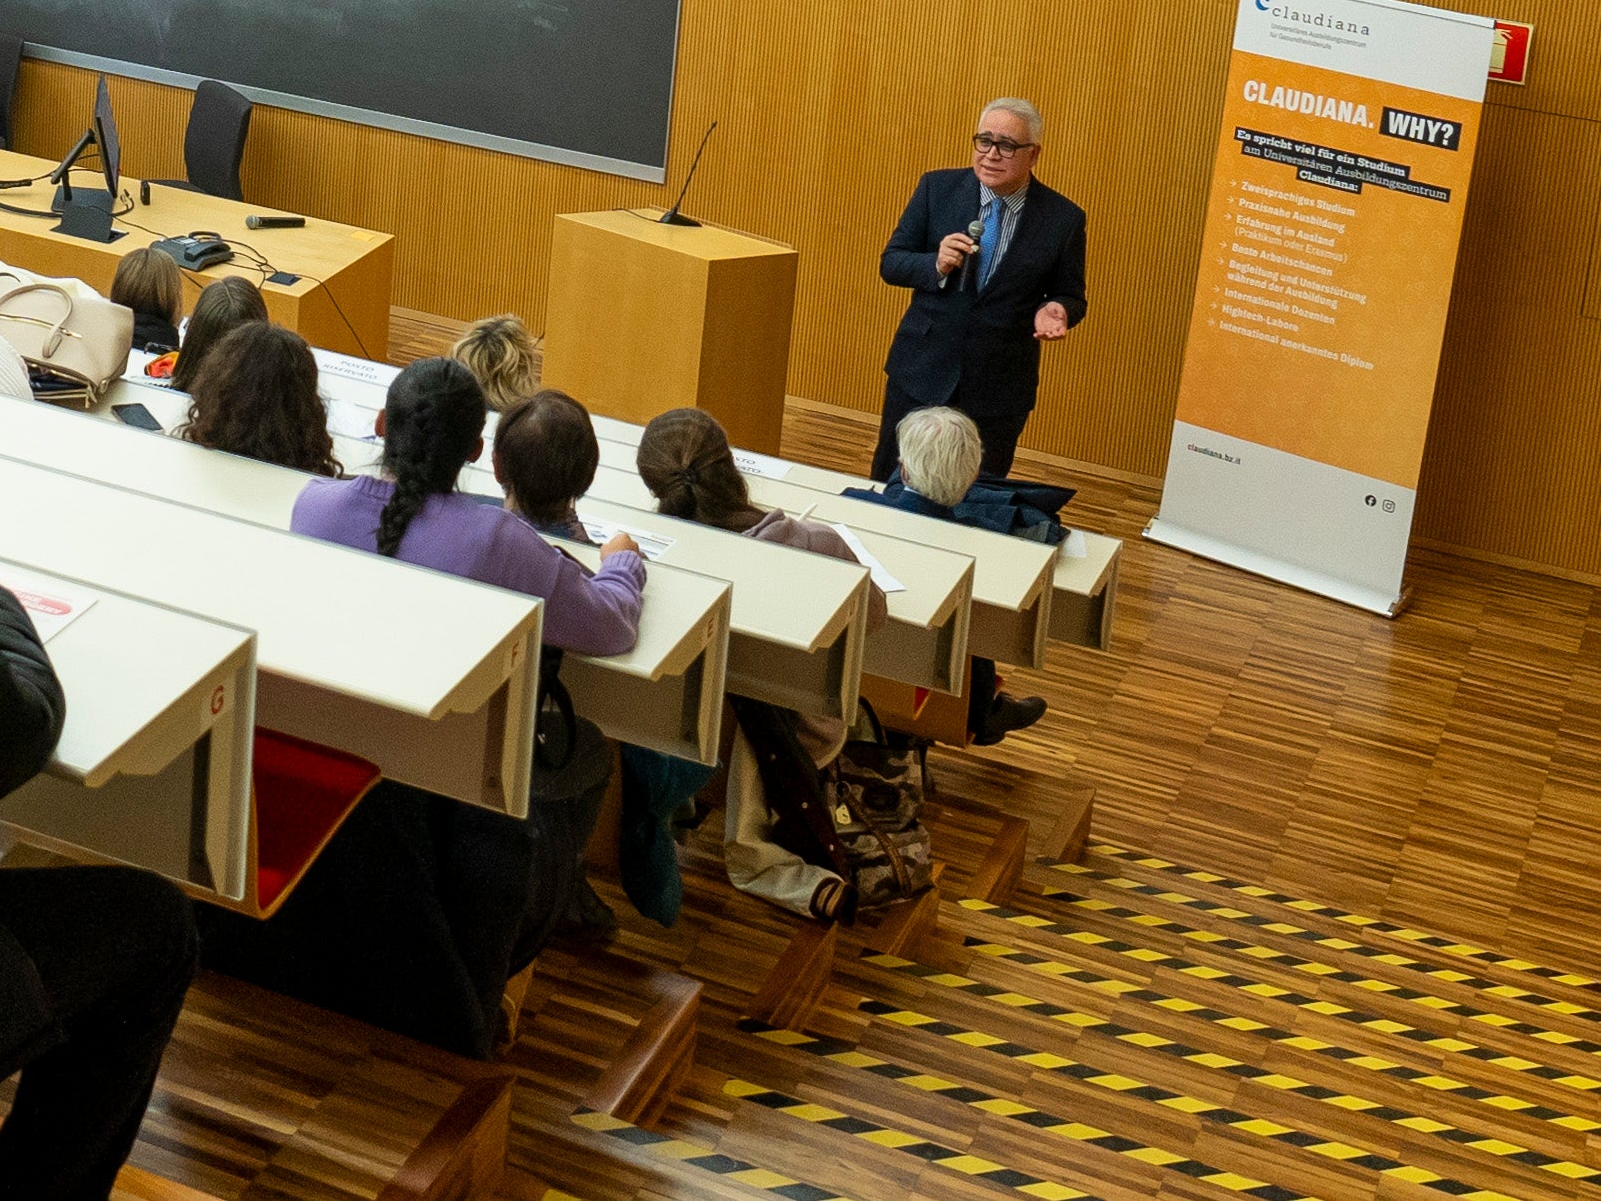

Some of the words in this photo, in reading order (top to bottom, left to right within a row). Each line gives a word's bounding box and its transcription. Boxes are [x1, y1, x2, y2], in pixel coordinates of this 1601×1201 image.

[1272, 7, 1369, 35] claudiana
[1243, 80, 1375, 129] CLAUDIANA.
[1389, 111, 1455, 147] WHY?
[1237, 129, 1251, 141] Es
[1253, 134, 1292, 152] spricht
[1295, 143, 1315, 155] viel
[1318, 147, 1335, 159] für
[1337, 152, 1355, 164] ein
[1358, 158, 1405, 177] Studium
[1244, 146, 1261, 157] am
[1264, 149, 1333, 173] Universitären
[1335, 166, 1447, 201] Ausbildungszentrum
[1299, 171, 1358, 191] Claudiana:
[1317, 200, 1355, 216] Studium
[1237, 215, 1282, 235] Erfahrung
[1283, 225, 1295, 235] im
[1292, 212, 1345, 233] Ausbildung
[1281, 273, 1299, 285] und
[1225, 288, 1289, 313] Internationale
[1285, 287, 1338, 310] Ausbildung
[1220, 321, 1279, 343] International
[1341, 353, 1374, 370] Diplom
[707, 617, 715, 638] E
[209, 685, 225, 715] G
